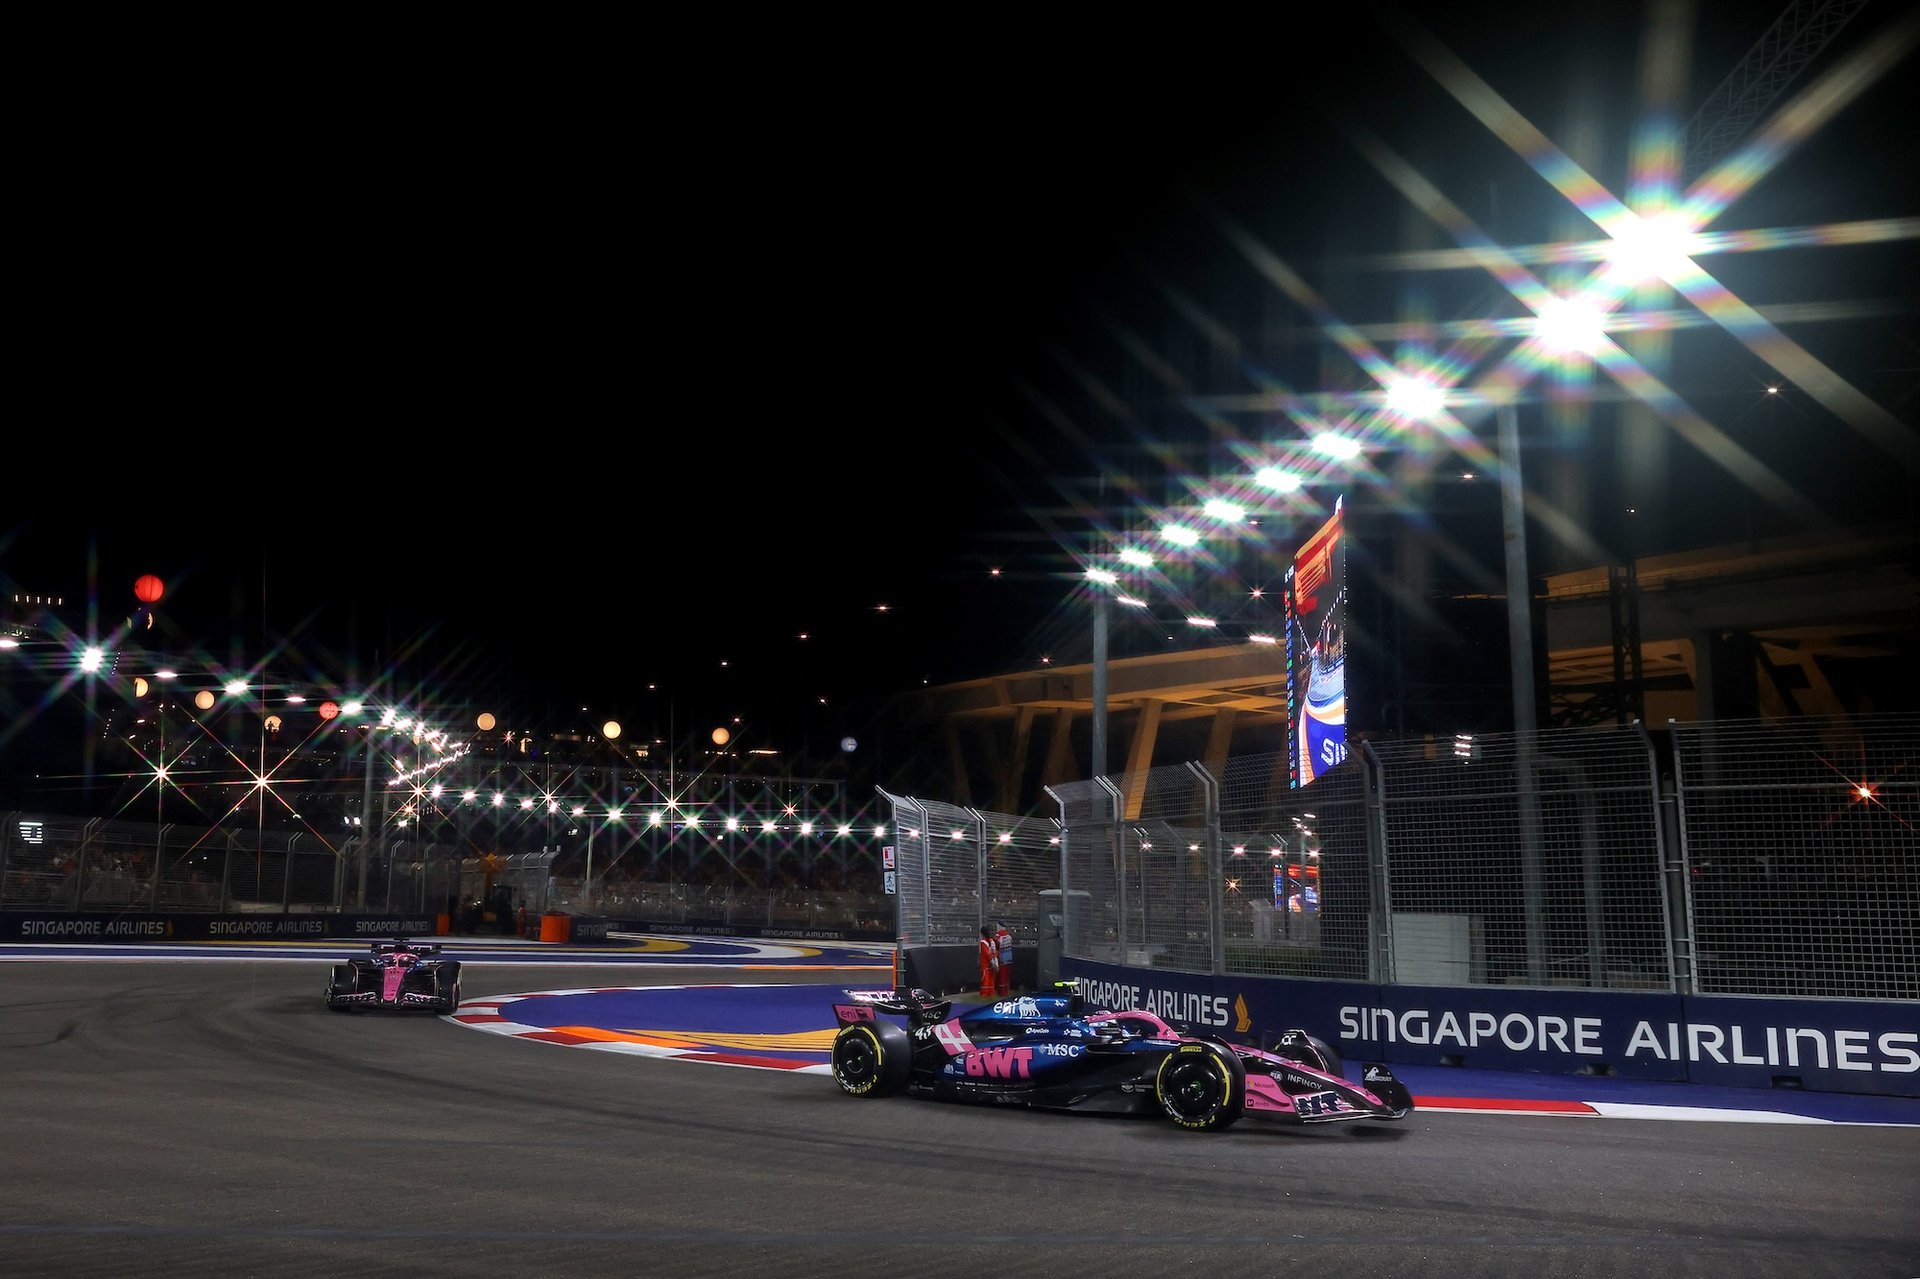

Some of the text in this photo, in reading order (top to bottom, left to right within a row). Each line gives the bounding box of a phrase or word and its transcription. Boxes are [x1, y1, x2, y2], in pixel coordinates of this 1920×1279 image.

[22, 920, 164, 935] SINGAPORE AIRLINES
[209, 920, 322, 934] SINGAPORE AIRLINES
[356, 921, 399, 933] SINGAPORE
[649, 924, 730, 935] SINGAPORE AIRLINES
[761, 929, 839, 939] SINGAPORE AIRLINES
[993, 998, 1017, 1014] eni
[1072, 976, 1229, 1027] SINGAPORE AIRLINES
[1340, 1006, 1920, 1073] SINGAPORE AIRLINES
[1046, 1043, 1080, 1058] MSC
[966, 1046, 1034, 1079] BWT
[1287, 1073, 1322, 1090] INFINOX
